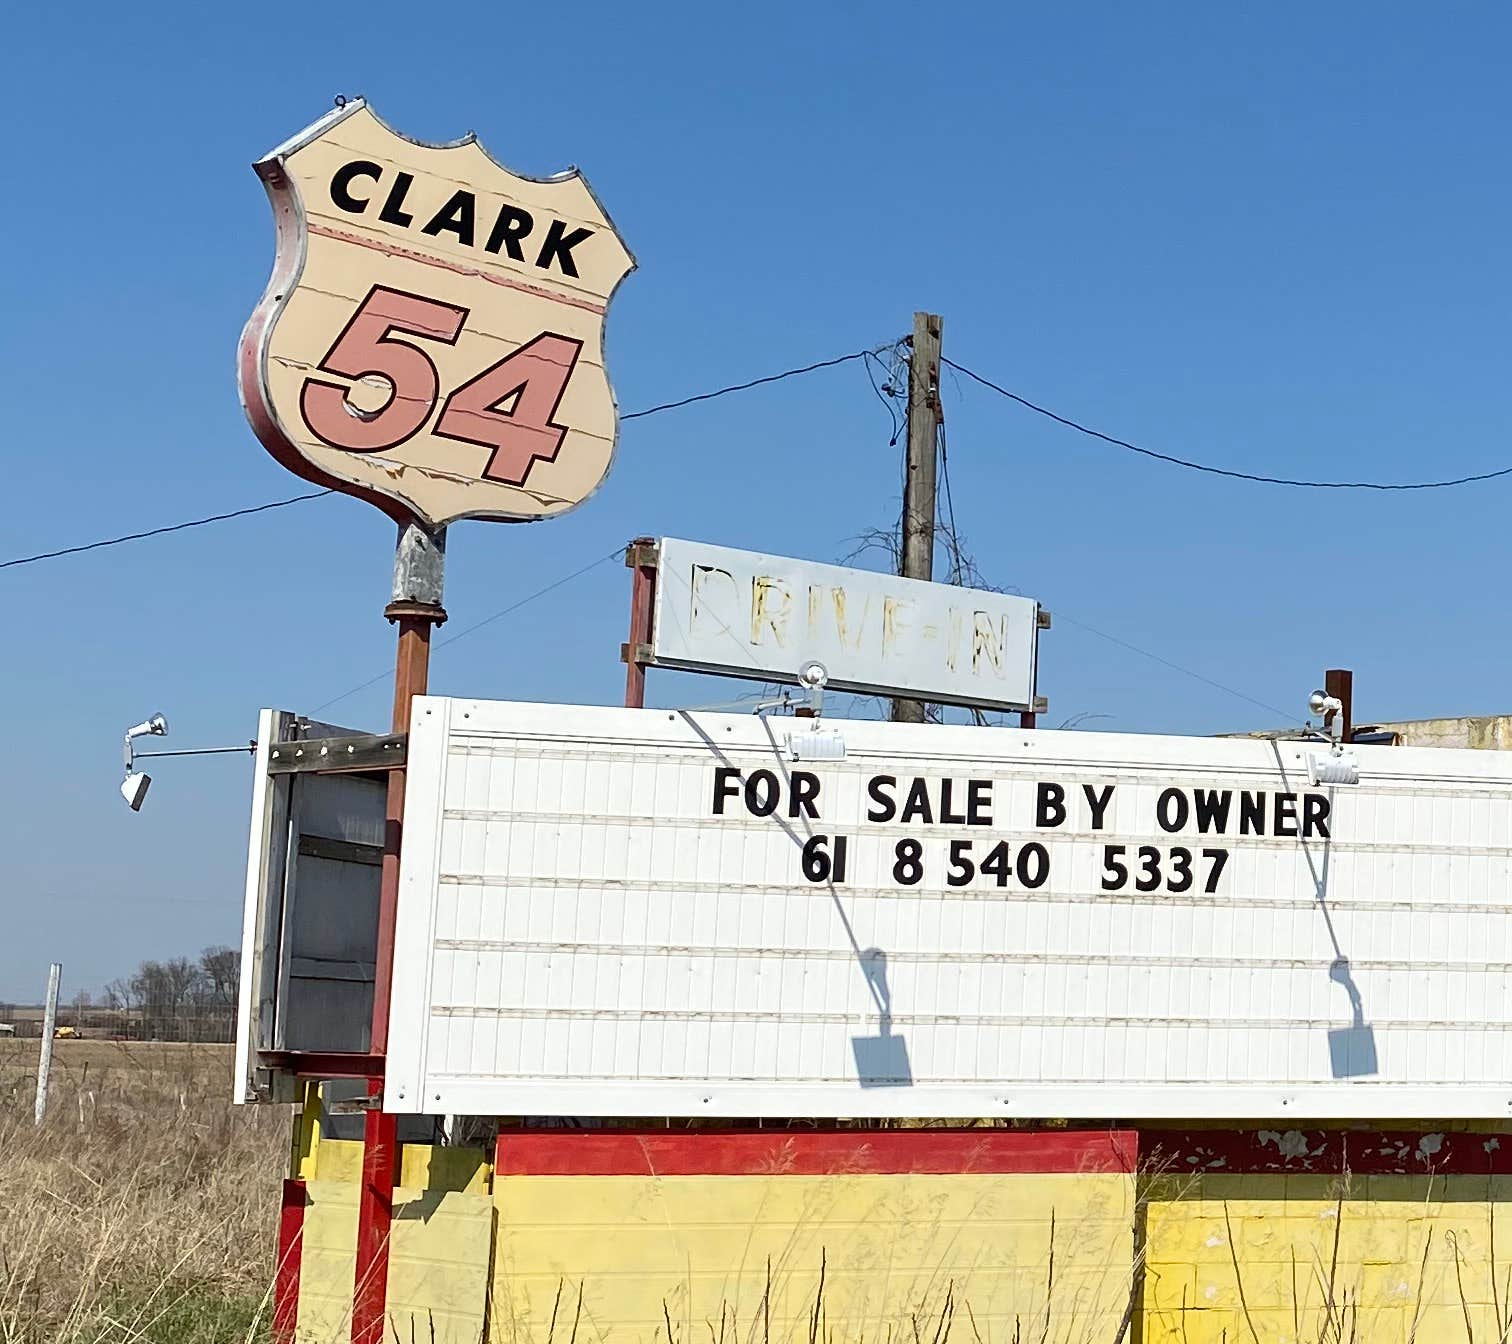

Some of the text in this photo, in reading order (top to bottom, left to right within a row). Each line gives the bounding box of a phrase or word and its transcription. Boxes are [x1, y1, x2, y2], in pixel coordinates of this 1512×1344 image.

[329, 160, 595, 279] CLARK
[299, 283, 584, 488] 54
[711, 767, 1332, 839] FOR SALE BY OWNER
[1100, 844, 1230, 894] 5337
